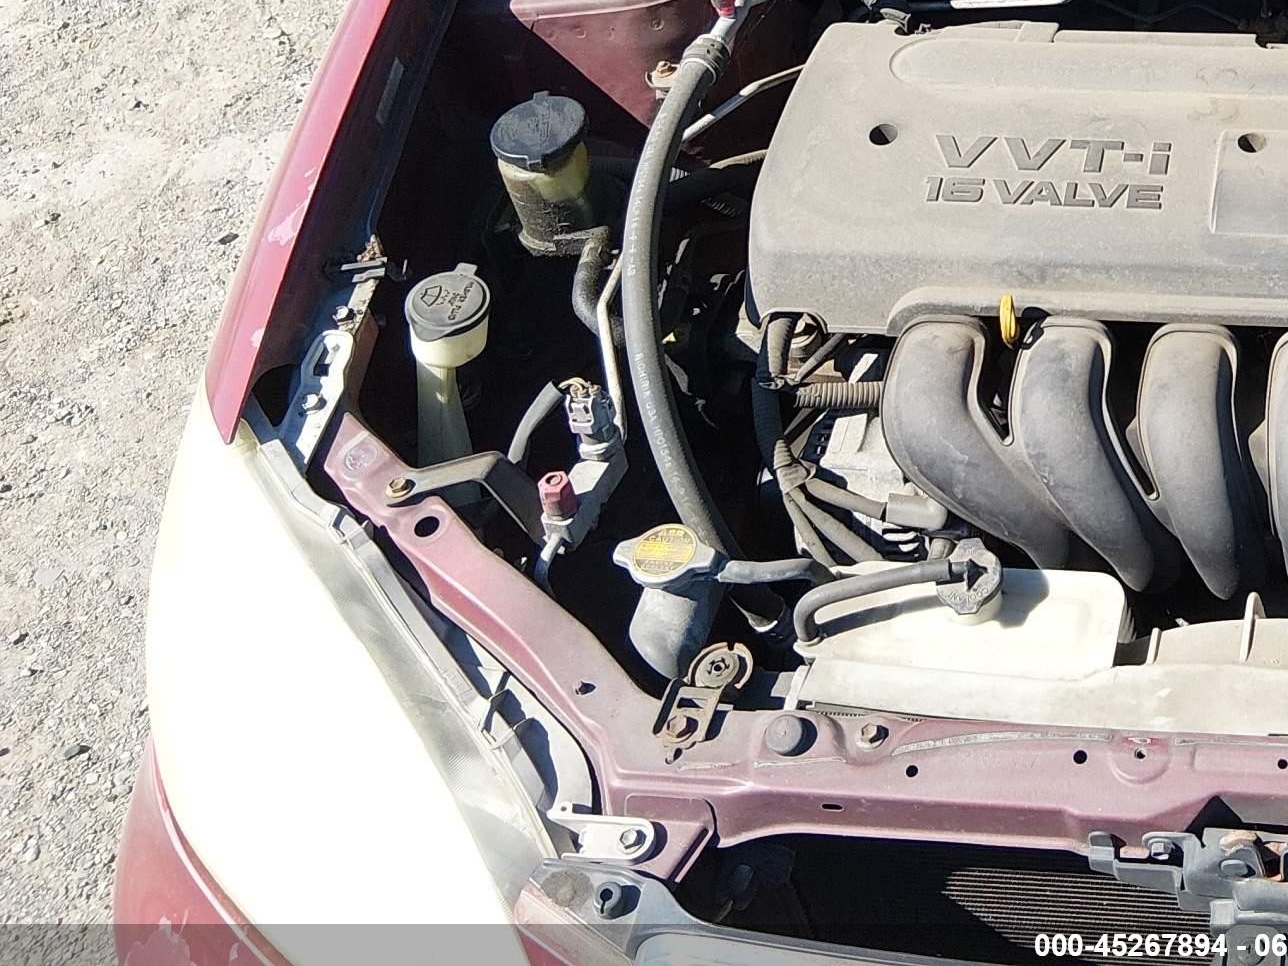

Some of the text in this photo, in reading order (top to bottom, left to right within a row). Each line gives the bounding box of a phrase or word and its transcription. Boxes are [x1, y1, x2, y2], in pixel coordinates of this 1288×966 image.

[935, 134, 1172, 175] VVT-i
[925, 176, 1165, 210] 16 VALVE
